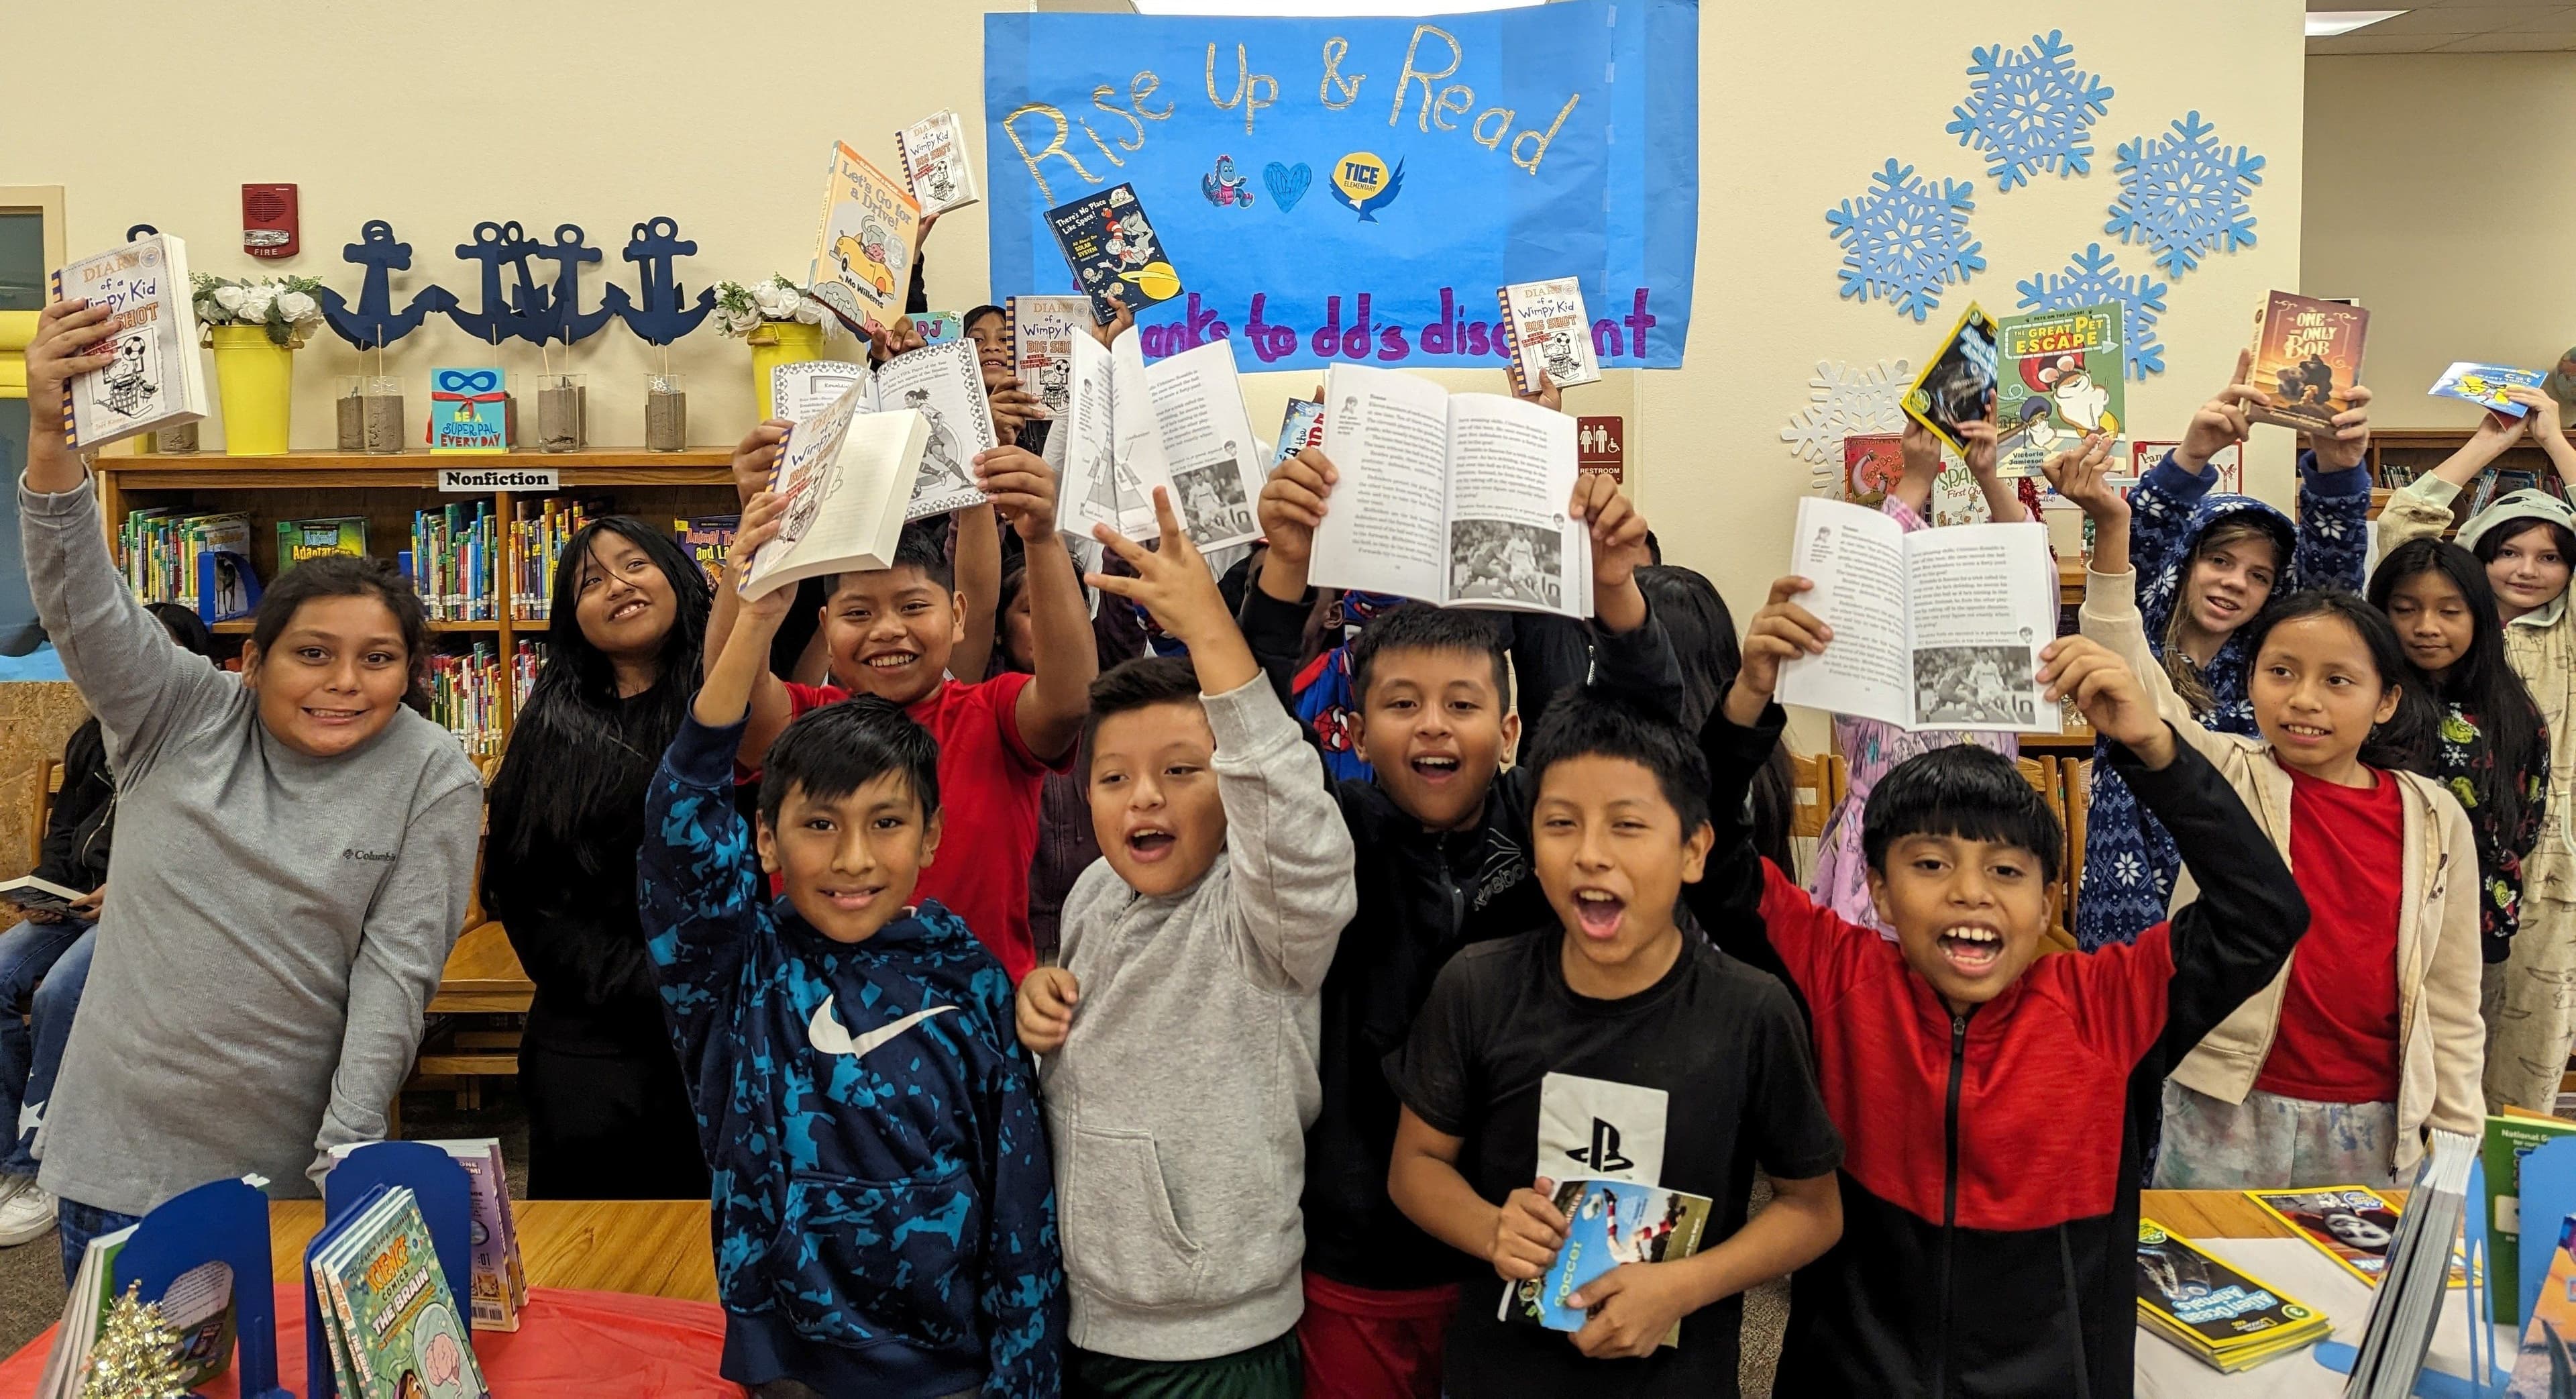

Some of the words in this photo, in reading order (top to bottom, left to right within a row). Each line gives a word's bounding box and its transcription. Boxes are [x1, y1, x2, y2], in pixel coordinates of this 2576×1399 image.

[1003, 70, 1175, 208] Rise
[1205, 42, 1279, 136] Up
[1320, 36, 1367, 110] &
[1389, 23, 1581, 176] Read
[910, 139, 936, 156] Wimpy
[936, 130, 949, 145] Kid
[1345, 162, 1380, 185] TICE
[842, 160, 873, 195] Let's
[875, 188, 893, 211] Go
[894, 203, 912, 225] for
[1344, 180, 1377, 193] ELEMENTARY
[850, 187, 859, 201] a
[862, 195, 900, 230] Drive!
[1055, 211, 1080, 227] There's
[1079, 206, 1089, 216] No
[1089, 199, 1107, 210] Place
[1061, 224, 1077, 236] Like
[1077, 211, 1097, 227] Space!
[1075, 242, 1092, 252] SOLAR
[1077, 246, 1098, 258] SYSTEM
[101, 278, 113, 291] of
[129, 277, 156, 303] Kid
[845, 275, 856, 289] Mo
[857, 284, 885, 310] Willems
[1044, 315, 1053, 323] of
[1518, 306, 1554, 319] Wimpy
[1556, 301, 1574, 313] Kid
[1244, 293, 1298, 364] to
[1311, 292, 1410, 362] dd's
[1420, 287, 1656, 360] discnt
[1524, 320, 1545, 333] BIG
[1546, 314, 1577, 330] SHOT
[2296, 312, 2326, 327] ONE
[1022, 323, 1062, 340] Wimpy
[2029, 324, 2072, 338] GREAT
[2302, 327, 2338, 342] ONLY
[1026, 340, 1047, 353] BIG
[2015, 331, 2098, 354] ESCAPE
[454, 411, 471, 423] BE
[474, 413, 483, 423] A
[443, 423, 477, 436] SUPER
[478, 423, 498, 435] PAL
[1295, 427, 1307, 446] the
[440, 433, 479, 448] EVERY
[481, 433, 501, 448] DAY
[792, 432, 833, 468] Wimpy
[2012, 450, 2044, 458] Victoria
[2008, 458, 2044, 466] Jamieson
[445, 471, 550, 486] Nonfiction
[1947, 487, 1966, 499] First
[686, 527, 720, 545] Animal
[696, 545, 715, 561] and
[2501, 1128, 2540, 1141] National
[365, 1233, 409, 1296] SCIENCE
[382, 1270, 409, 1301] COMICS
[372, 1304, 397, 1338] THE
[393, 1265, 431, 1313] BRAIN
[2178, 1287, 2245, 1310] Animals
[2225, 1292, 2274, 1313] Alien
[2179, 1306, 2233, 1323] Ocean
[351, 1333, 363, 1354] THE
[357, 1352, 374, 1383] BRAIN
